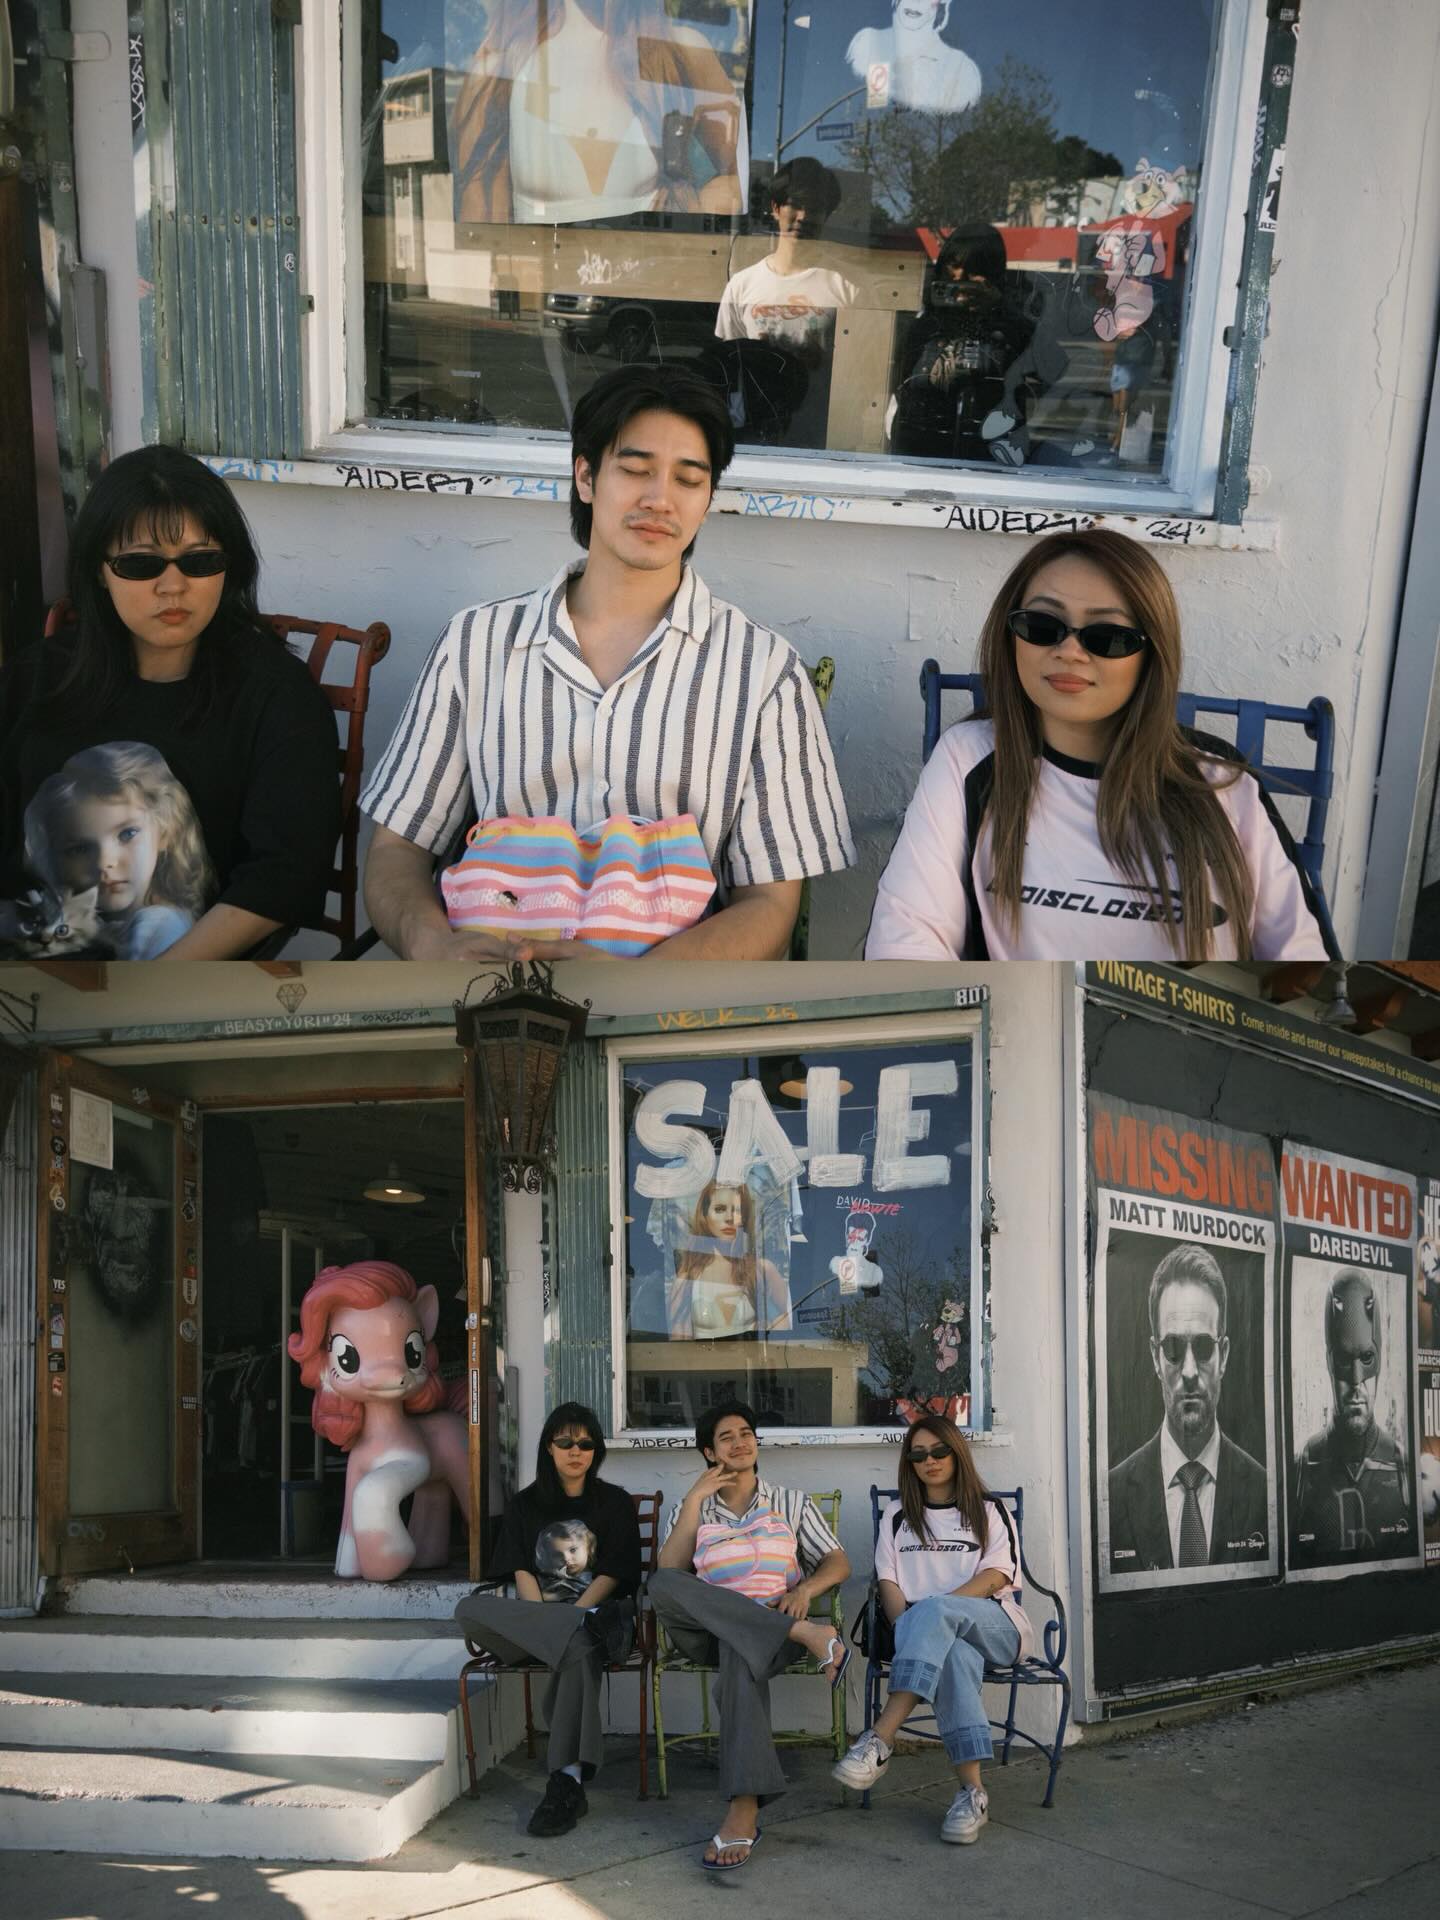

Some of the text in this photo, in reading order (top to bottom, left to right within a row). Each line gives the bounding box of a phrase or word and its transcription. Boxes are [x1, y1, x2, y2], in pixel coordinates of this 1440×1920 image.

[1096, 960, 1167, 1003] VINTAGE
[1169, 981, 1236, 1026] T-SHIRTS
[1241, 1012, 1265, 1033] Come
[1265, 1021, 1290, 1041] inside
[1290, 1031, 1306, 1047] and
[1307, 1037, 1328, 1052] enter
[1328, 1043, 1342, 1057] our
[1341, 1048, 1386, 1074] sweepstakes
[1400, 1067, 1424, 1088] chance
[633, 1059, 960, 1199] SALE
[1093, 1110, 1274, 1216] MISSING
[836, 1194, 871, 1207] DAVID
[1109, 1197, 1266, 1247] MATT MURDOCK
[1280, 1154, 1414, 1240] WANTED
[1308, 1231, 1394, 1268] DAREDEVIL
[899, 1544, 965, 1553] UNDISCLOSED
